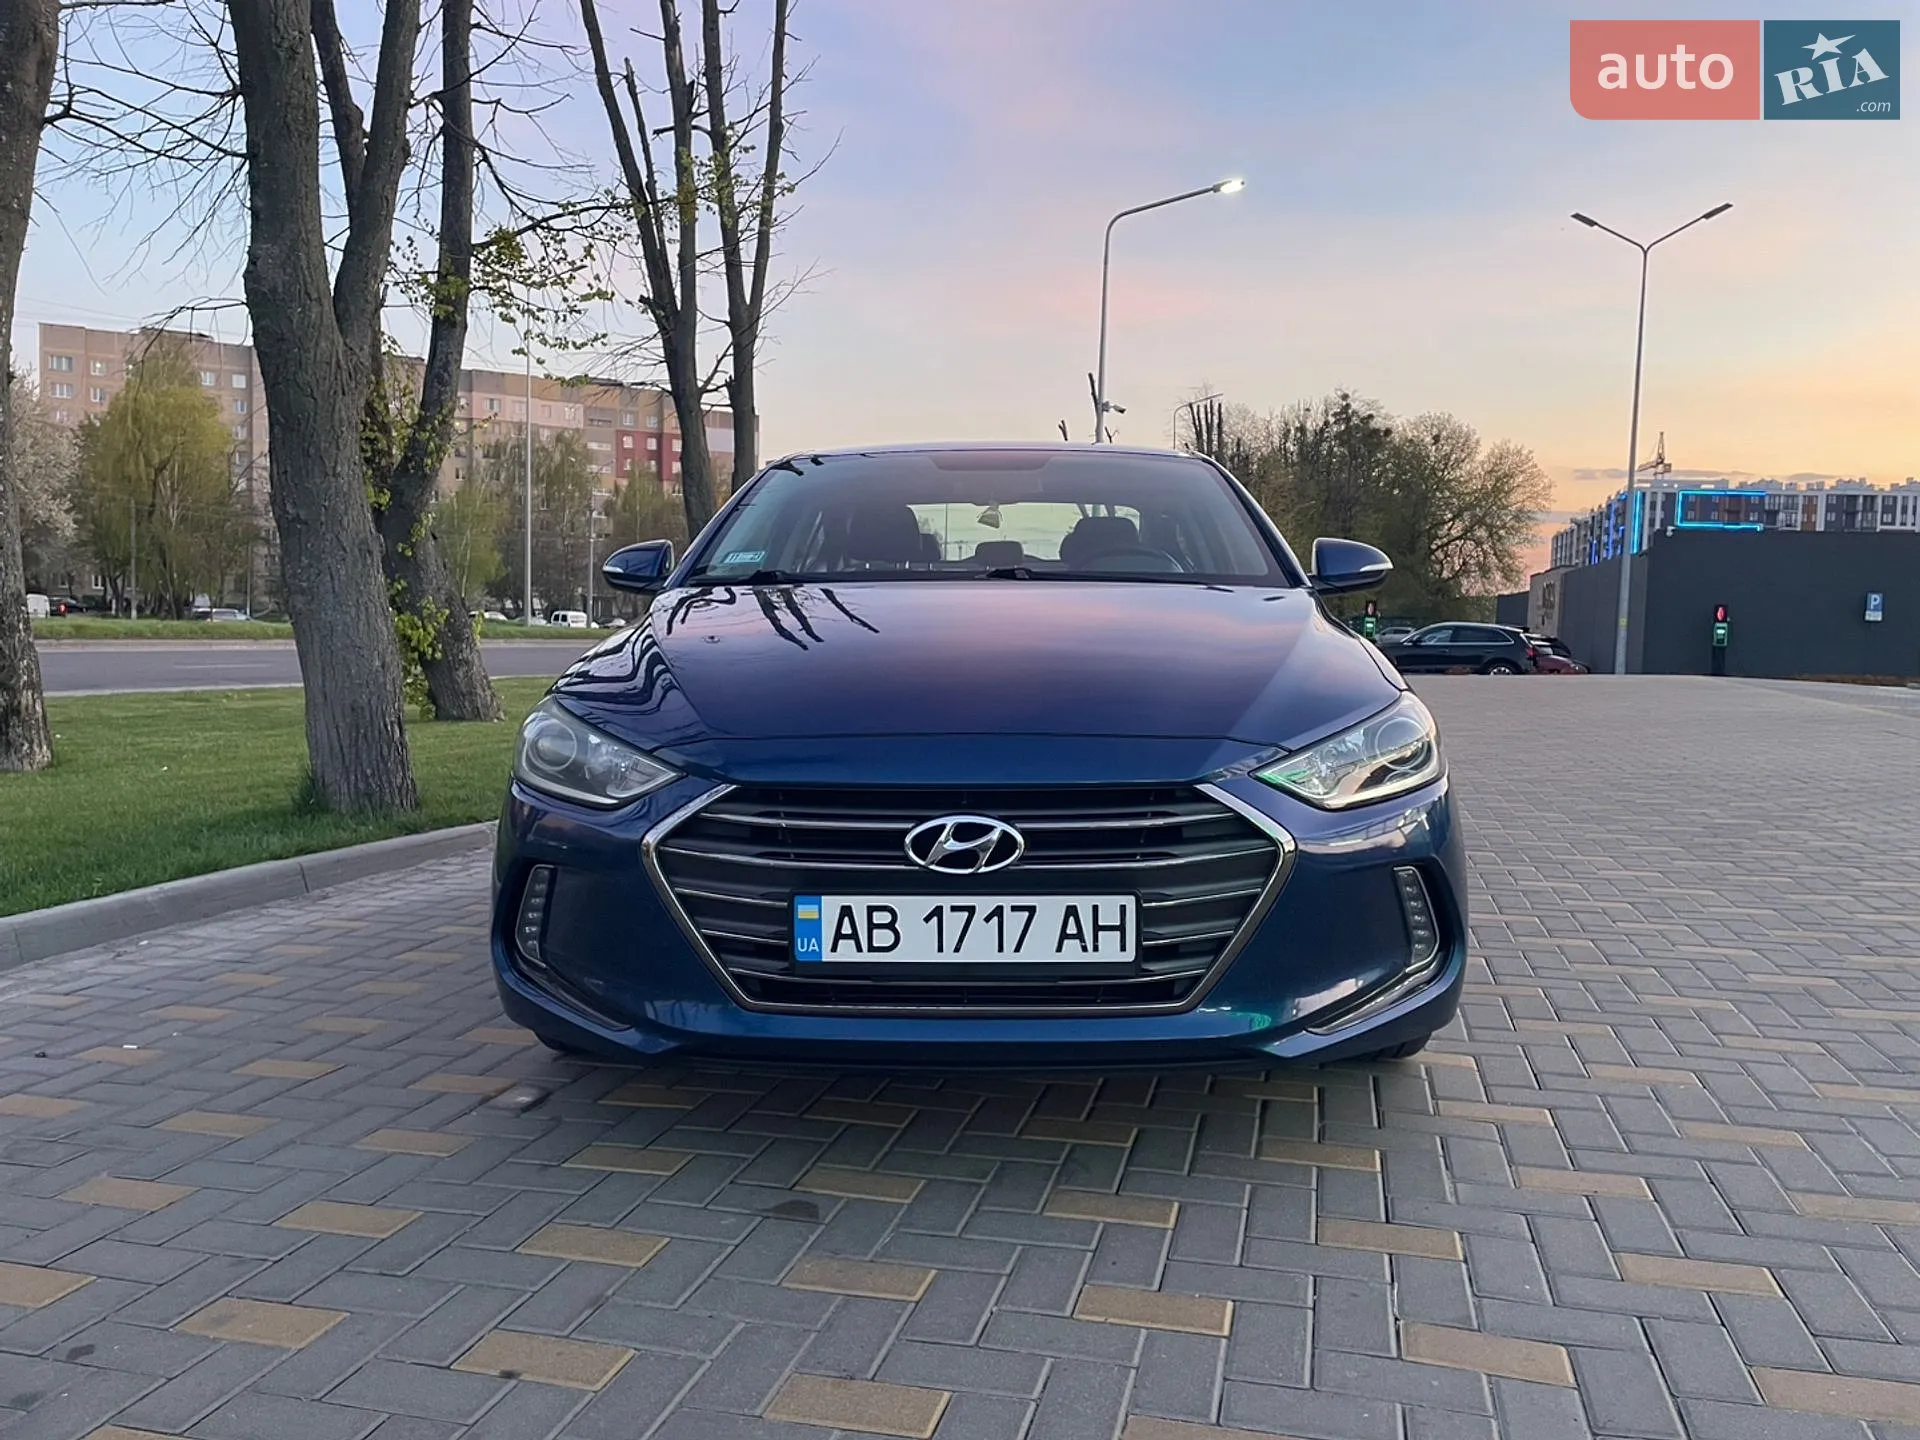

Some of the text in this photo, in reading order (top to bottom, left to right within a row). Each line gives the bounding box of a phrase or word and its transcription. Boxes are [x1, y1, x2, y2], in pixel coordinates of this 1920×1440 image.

[1870, 594, 1880, 609] P
[830, 904, 1127, 953] AB 1717 AH
[797, 938, 819, 952] UA
